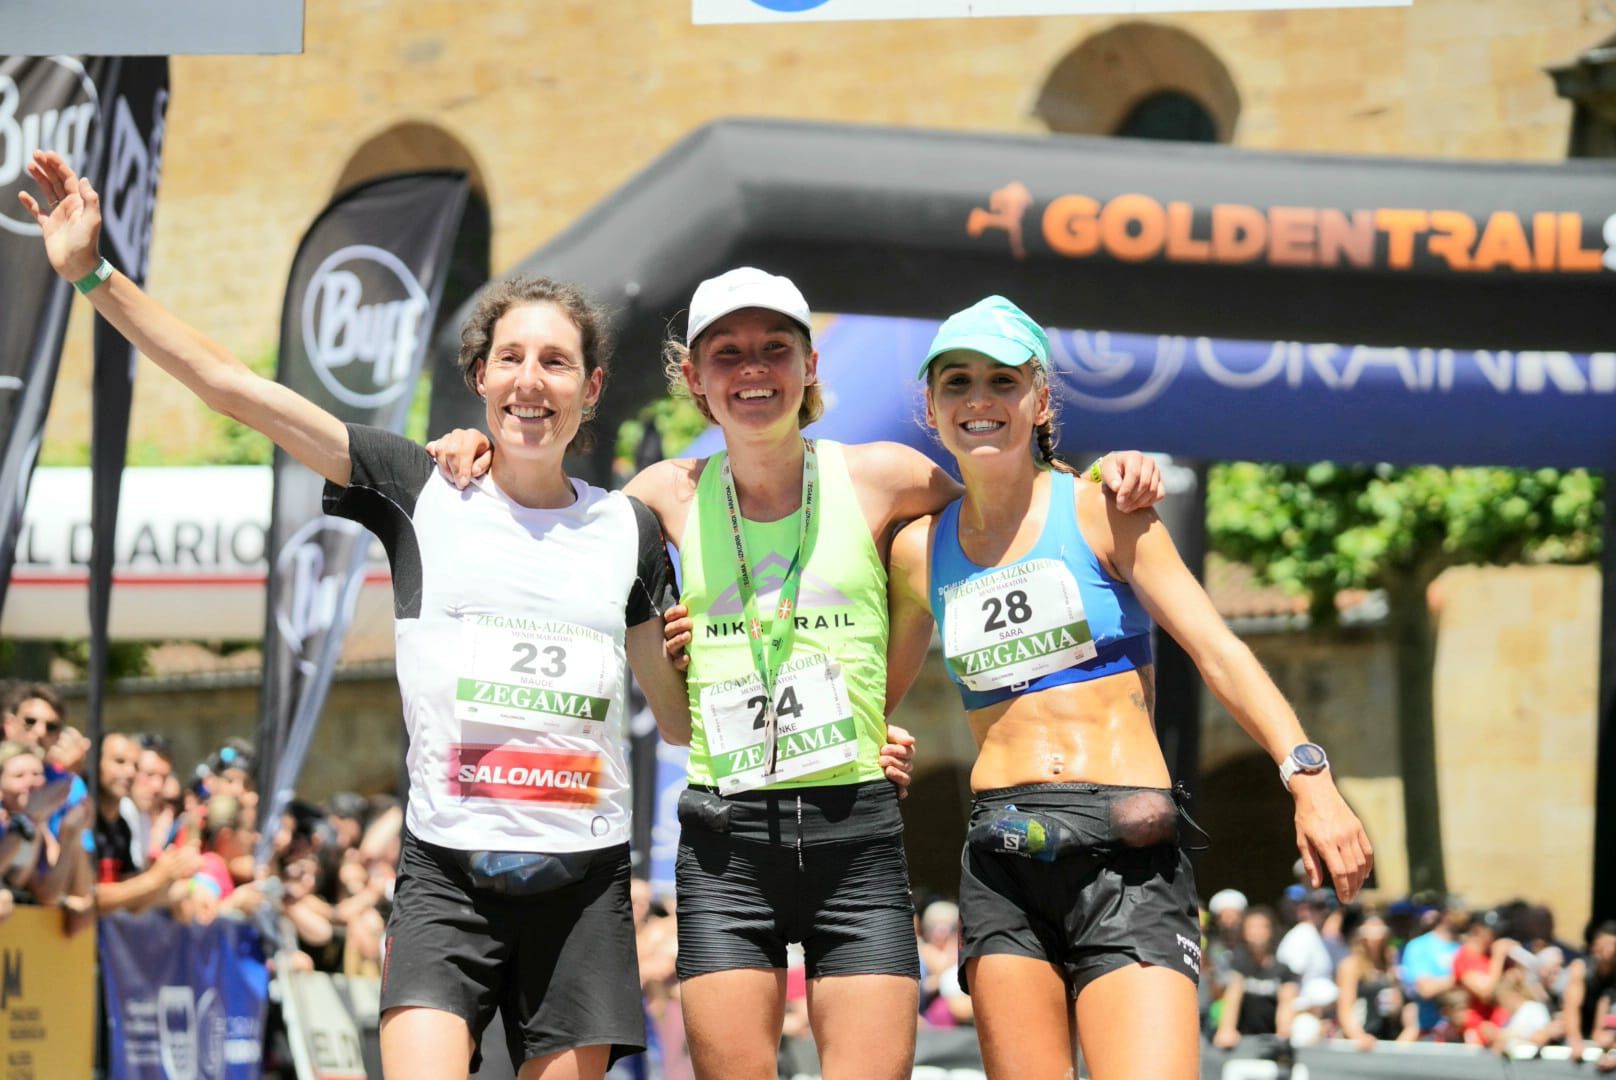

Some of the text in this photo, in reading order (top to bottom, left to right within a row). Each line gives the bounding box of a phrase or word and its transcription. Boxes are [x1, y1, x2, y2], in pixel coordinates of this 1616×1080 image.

[318, 271, 428, 385] Buff
[69, 521, 268, 566] DARIO
[706, 613, 855, 638] NIK RAIL
[981, 590, 1033, 633] 28
[962, 627, 1078, 675] ZEGAMA
[999, 627, 1024, 640] SARA
[510, 642, 567, 678] 23
[472, 682, 593, 718] ZEGAMA
[520, 677, 553, 688] MAUDE
[747, 685, 804, 731] 24
[729, 724, 846, 773] ZEAMA
[458, 764, 592, 789] SALOMON
